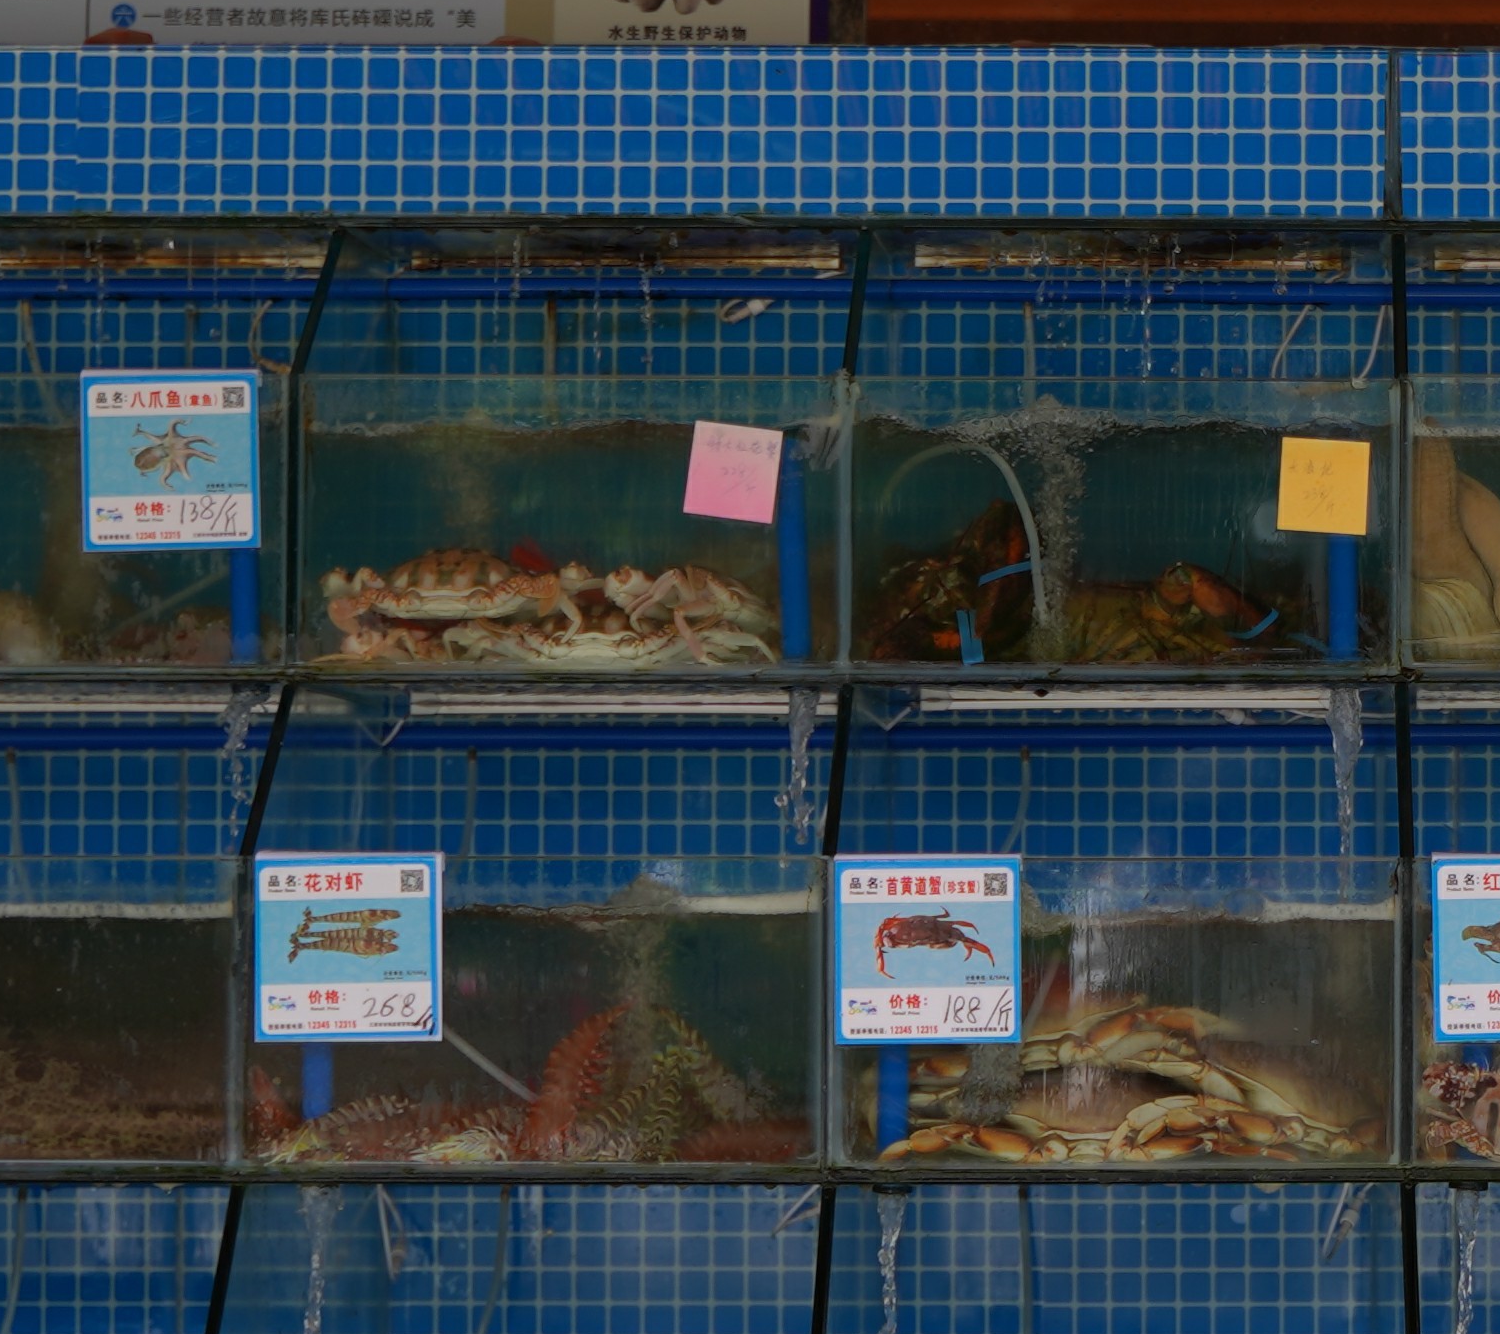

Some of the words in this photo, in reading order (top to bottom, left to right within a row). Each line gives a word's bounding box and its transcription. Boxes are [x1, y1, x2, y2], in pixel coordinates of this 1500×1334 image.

[608, 24, 747, 42] 水生野生保护动物
[134, 501, 171, 517] 价格:
[308, 990, 346, 1004] 价格:
[889, 993, 928, 1009] 价格:
